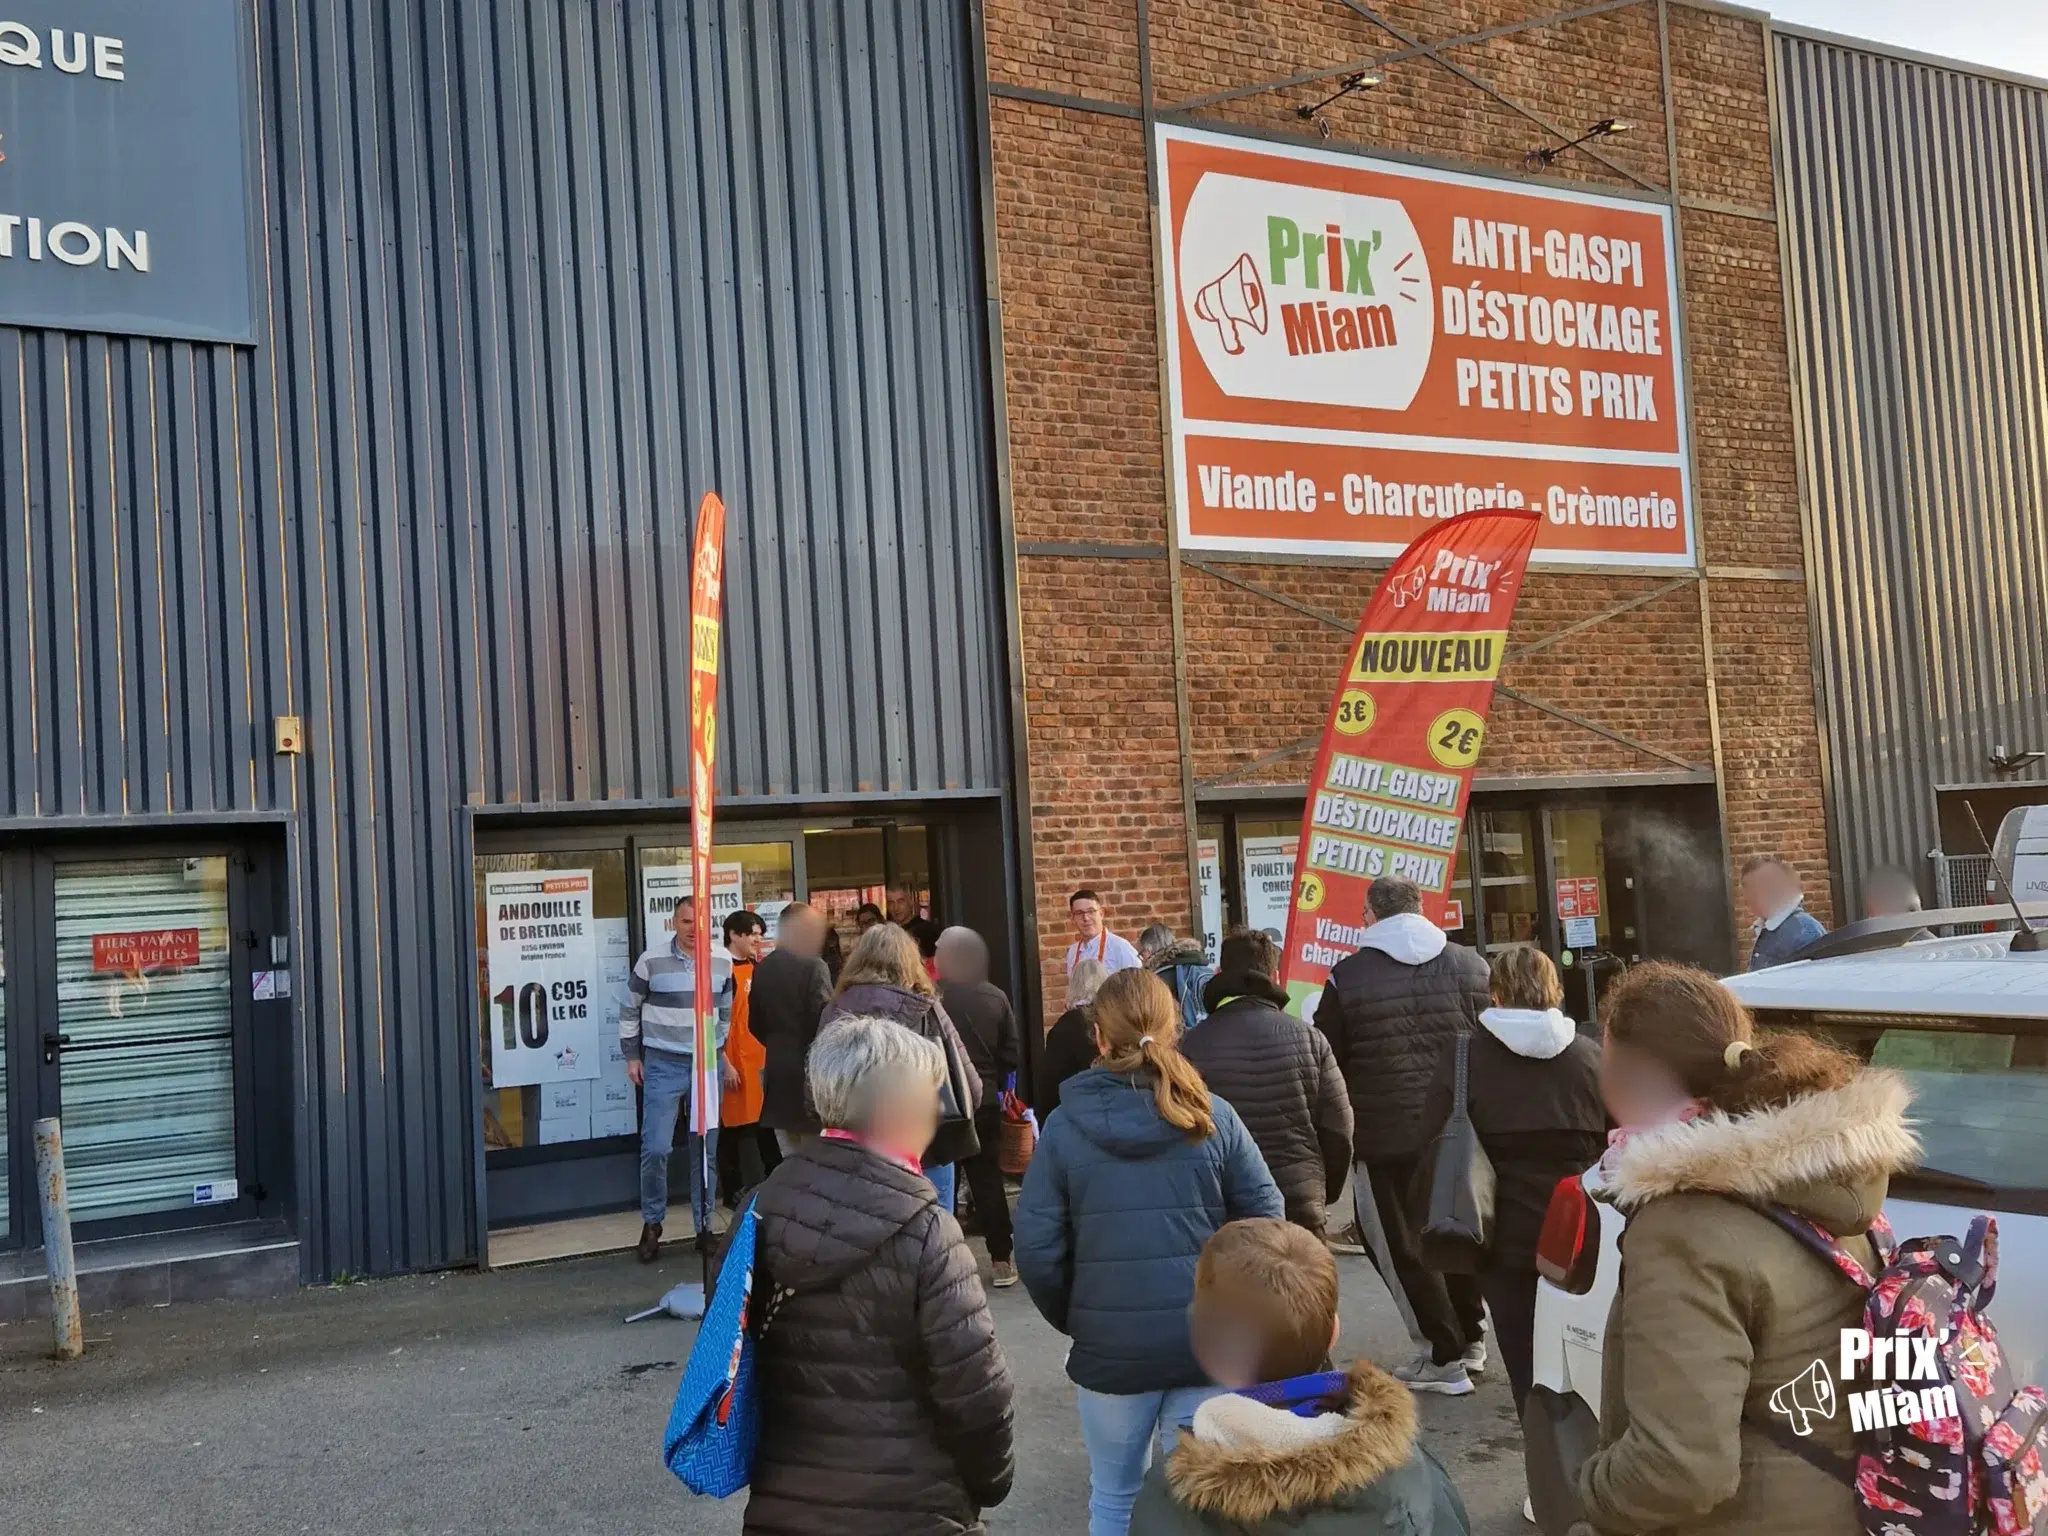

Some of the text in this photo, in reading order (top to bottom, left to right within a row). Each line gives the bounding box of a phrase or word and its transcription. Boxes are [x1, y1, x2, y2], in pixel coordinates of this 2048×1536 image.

[0, 21, 125, 81] QUE
[1266, 215, 1382, 297] Prix'
[1451, 216, 1645, 288] ANTI-GASPI
[1280, 302, 1398, 357] Miam
[1441, 280, 1663, 356] DÉSTOCKAGE
[1456, 357, 1659, 423] PETITS PRIX
[1198, 464, 1317, 513] Viande
[1342, 473, 1525, 519] Charcuterie
[1547, 485, 1678, 530] Crèmerie
[1426, 586, 1492, 614] Miam
[1360, 636, 1493, 674] NOUVEAU
[1339, 699, 1367, 724] 3€
[1437, 720, 1480, 755] 2€
[1329, 755, 1458, 810] ANTI-GASPI
[1313, 793, 1457, 850] DÉSTOCKAGE
[1251, 862, 1285, 877] POULET
[1311, 837, 1444, 889] PETITS PRIX
[1262, 880, 1293, 893] CONGE
[499, 900, 582, 921] ANDOUILLE
[501, 923, 583, 941] DE BRETAGNE
[100, 933, 194, 950] TIERS PAYANT
[105, 947, 188, 965] MUTUELLES
[494, 979, 588, 1050] 10 €95
[552, 1003, 587, 1021] LE KG
